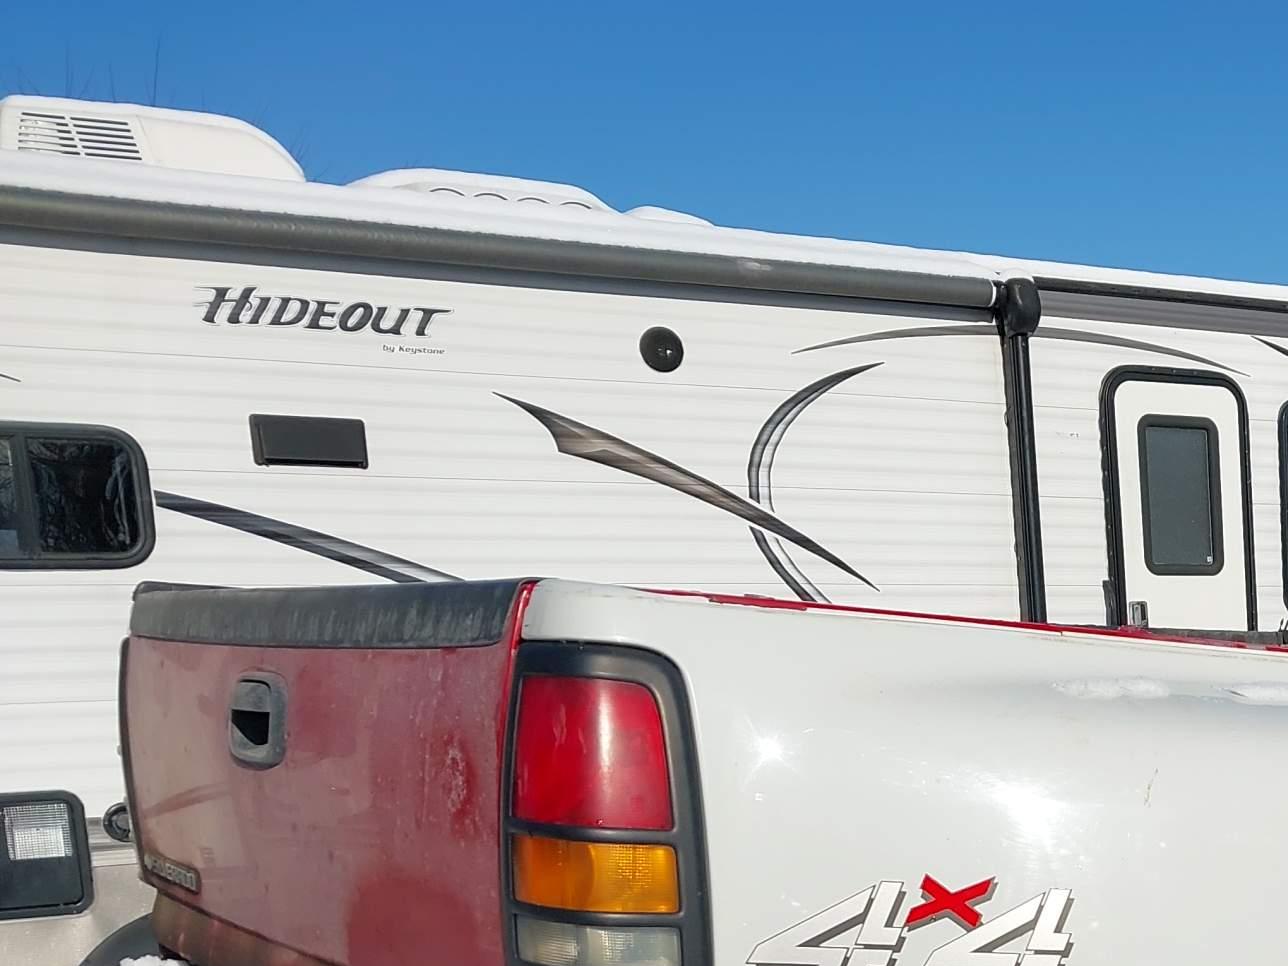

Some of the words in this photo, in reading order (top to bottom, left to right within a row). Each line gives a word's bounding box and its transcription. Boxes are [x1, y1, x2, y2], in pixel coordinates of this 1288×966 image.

[195, 286, 454, 337] HIDEOUT
[382, 344, 396, 354] by
[398, 344, 446, 355] Keystone
